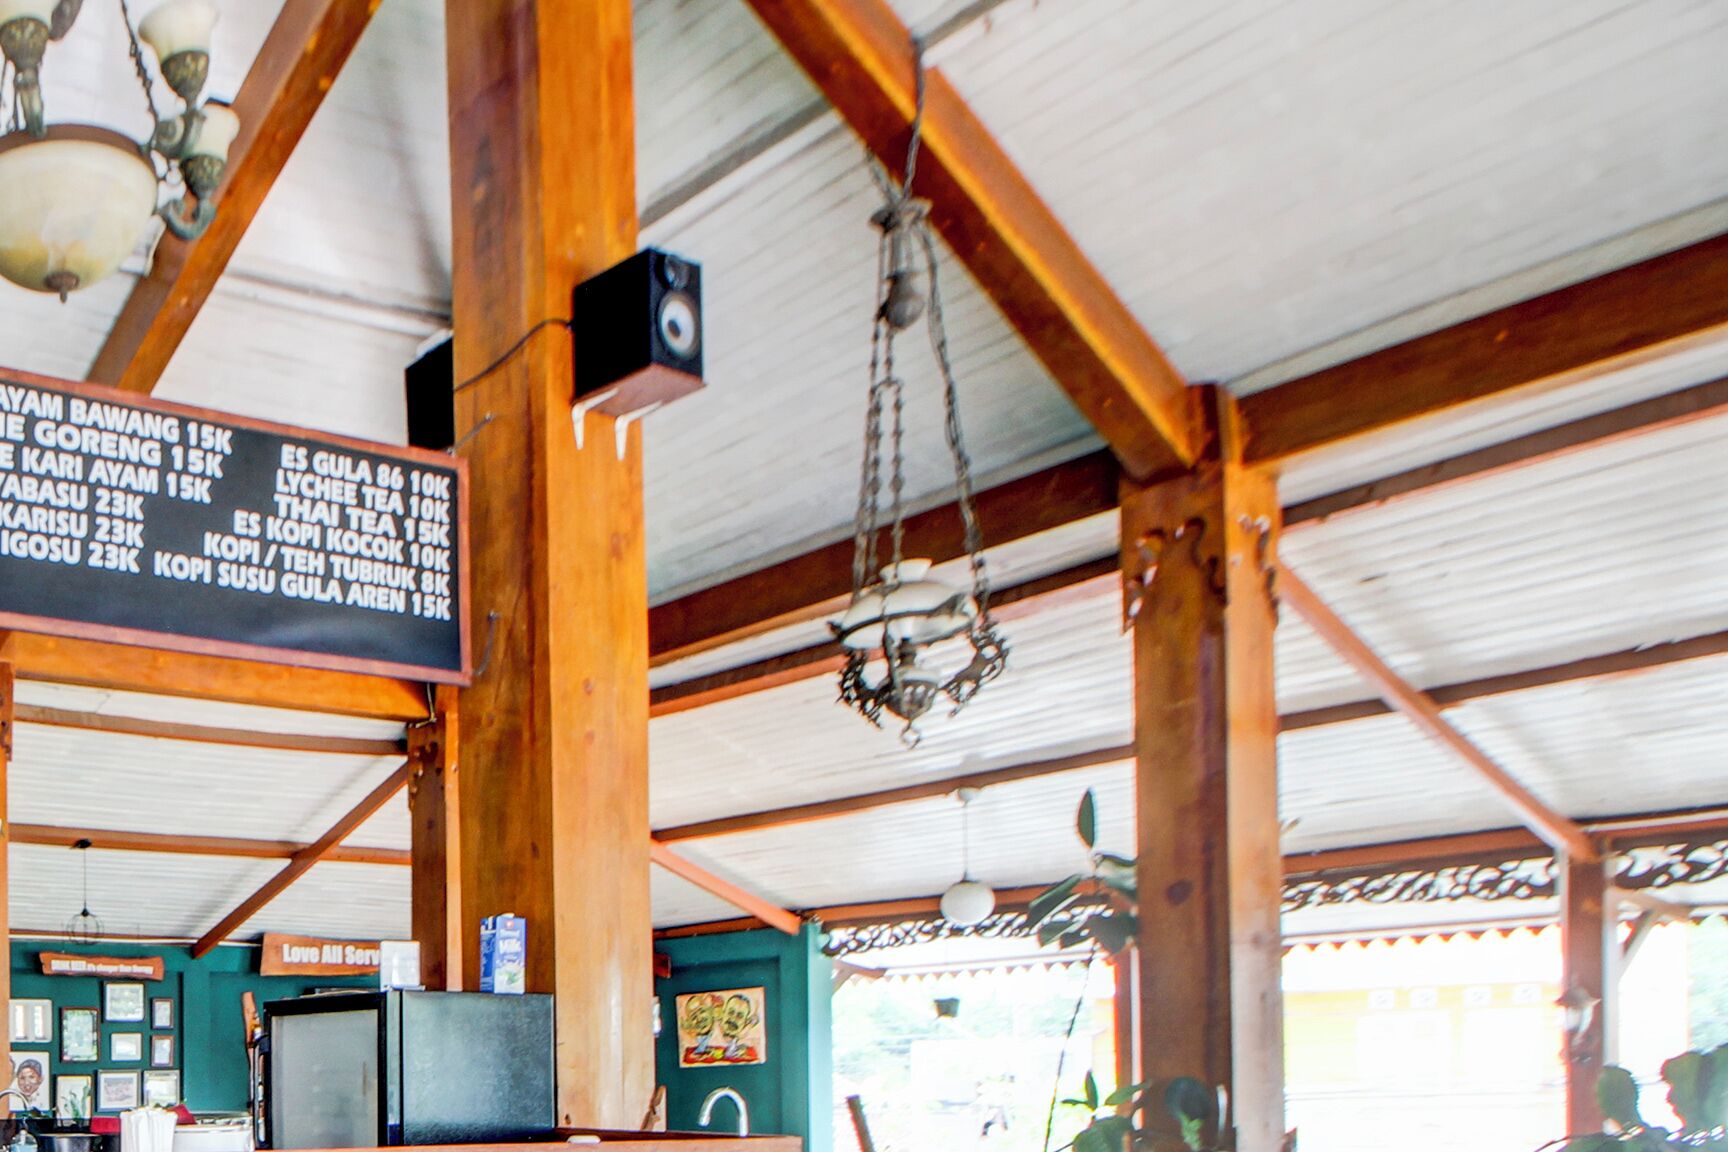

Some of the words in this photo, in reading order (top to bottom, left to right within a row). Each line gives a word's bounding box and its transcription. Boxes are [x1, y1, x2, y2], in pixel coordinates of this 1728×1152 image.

[34, 420, 162, 466] GORENG
[171, 445, 223, 478] 15K
[70, 398, 180, 443] BAWANG
[187, 421, 233, 455] 15K
[22, 446, 83, 481] KARI
[88, 459, 159, 494] AYAM
[166, 472, 212, 504] 15K
[276, 469, 358, 505] LYCHEE
[362, 485, 405, 516] TEA
[410, 495, 450, 524] 10K
[281, 443, 308, 471] ES
[313, 451, 372, 485] GULA
[377, 463, 404, 490] 86
[410, 470, 450, 500] 10K
[95, 488, 144, 521] 23K
[95, 516, 144, 548] 23K
[274, 493, 339, 527] THAI
[345, 506, 397, 537] TEA
[404, 518, 450, 548] 15K
[1, 529, 81, 565] IGOSU
[88, 541, 140, 573] 23K
[204, 531, 260, 564] KOPI
[264, 544, 278, 567] /
[280, 546, 325, 575] TEH
[329, 554, 416, 591] TUBRUK
[421, 570, 450, 597] 8K
[233, 509, 261, 537] ES
[266, 515, 321, 549] KOPI
[326, 527, 404, 563] KOCOK
[410, 542, 450, 573] 10K
[154, 551, 212, 584] KOPI
[217, 561, 276, 594] SUSU
[280, 572, 344, 604] GULA
[346, 582, 406, 613] AREN
[412, 592, 451, 621] 15K
[282, 943, 319, 963] Love
[321, 945, 343, 964] All
[345, 945, 381, 965] Serv
